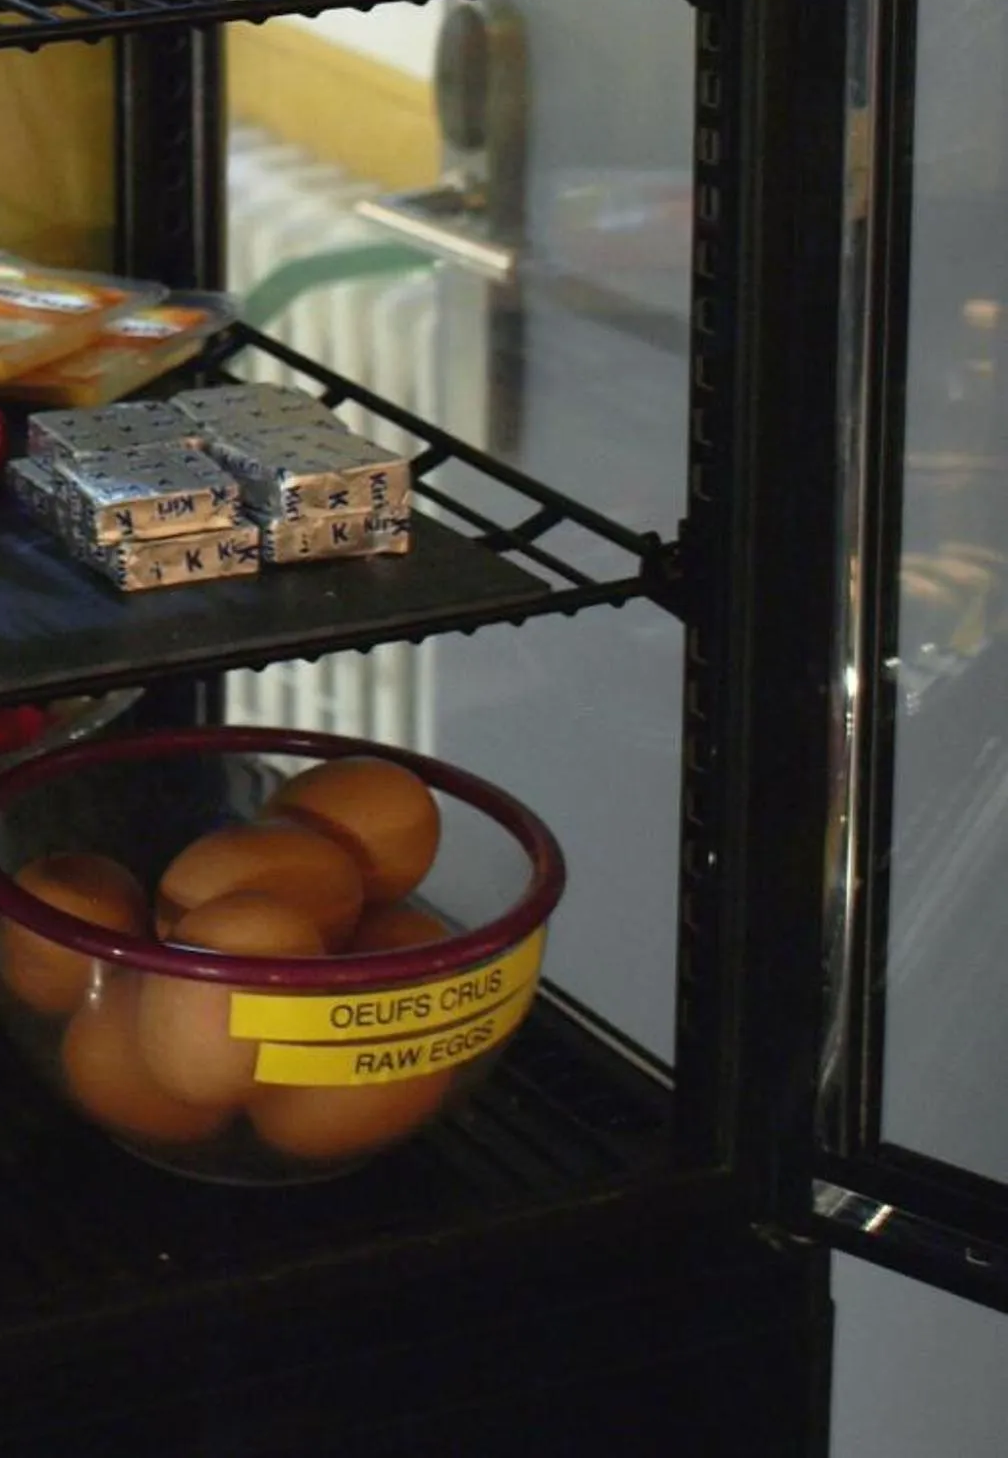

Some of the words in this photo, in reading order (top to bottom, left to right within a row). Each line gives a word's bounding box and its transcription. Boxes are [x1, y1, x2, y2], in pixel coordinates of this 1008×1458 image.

[186, 548, 204, 572] K
[329, 993, 431, 1029] OEUFS
[440, 968, 503, 1011] CRUS
[355, 1045, 423, 1075] RAW
[428, 1019, 496, 1061] EGGS
